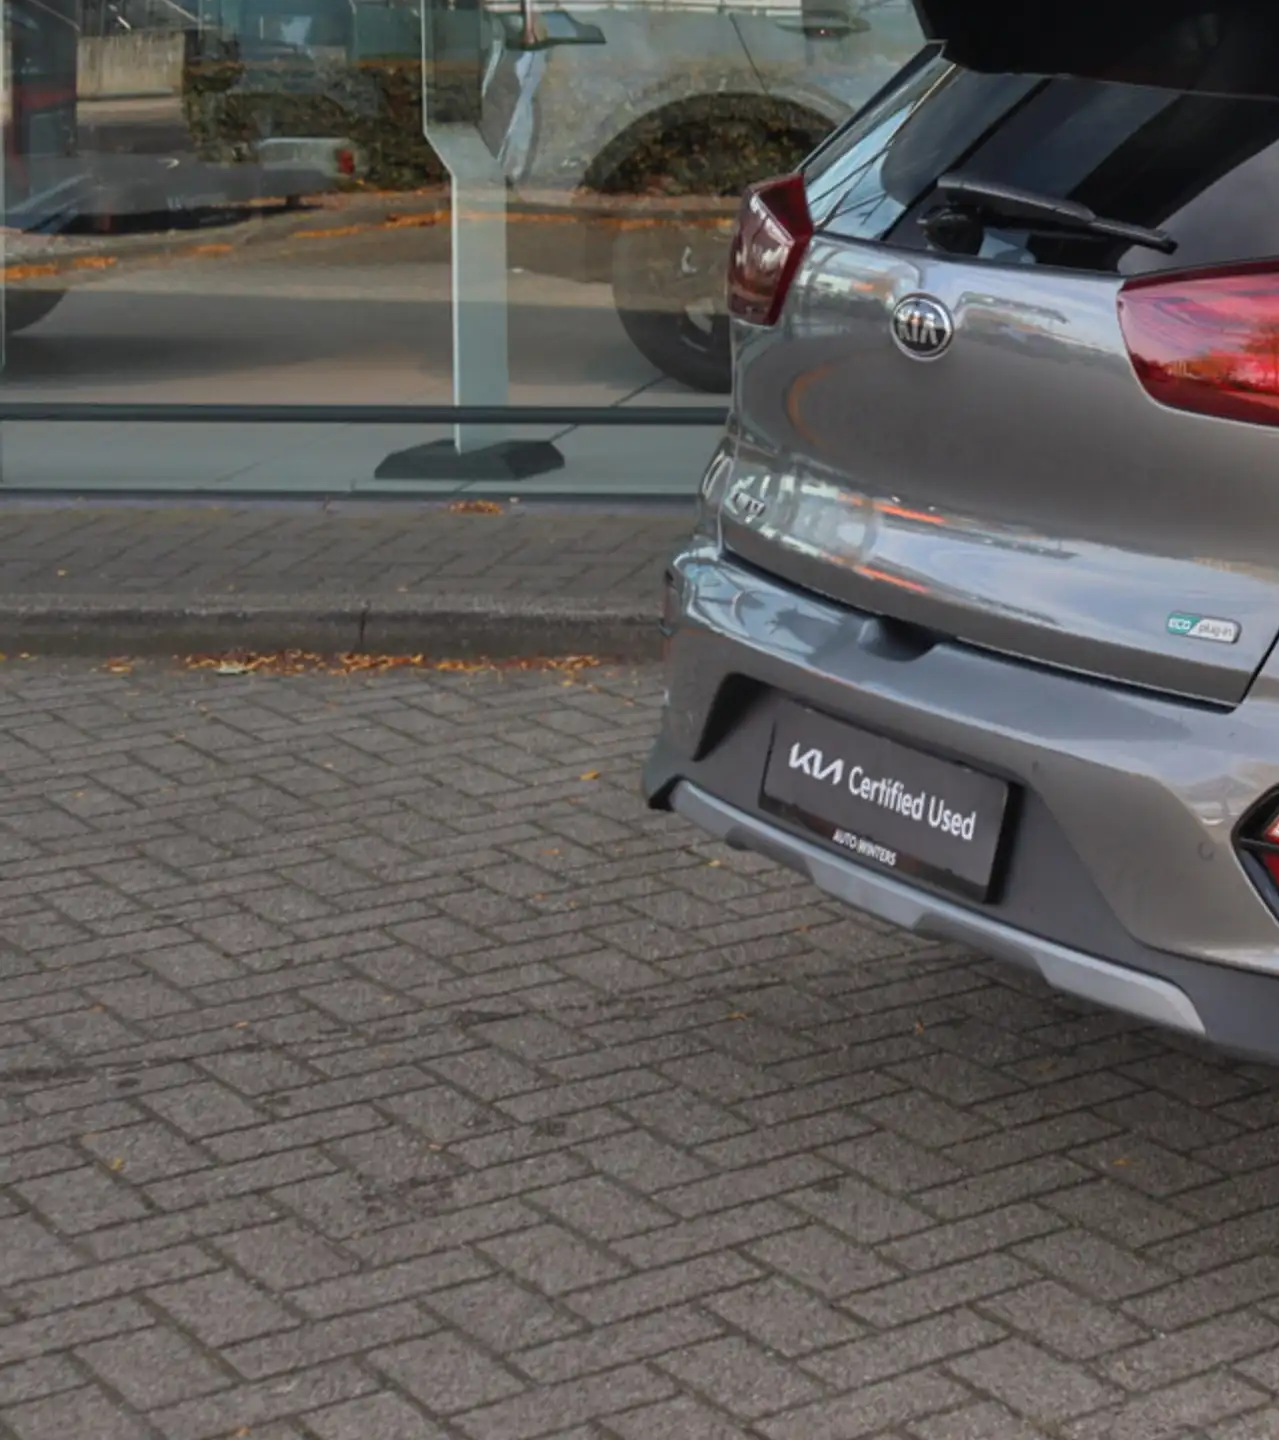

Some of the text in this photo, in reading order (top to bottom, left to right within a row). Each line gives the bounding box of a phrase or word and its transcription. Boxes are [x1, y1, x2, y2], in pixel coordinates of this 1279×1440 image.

[897, 310, 938, 346] KIA
[789, 742, 976, 840] KIA Certified Used
[833, 828, 897, 866] AUTO WINTERS
